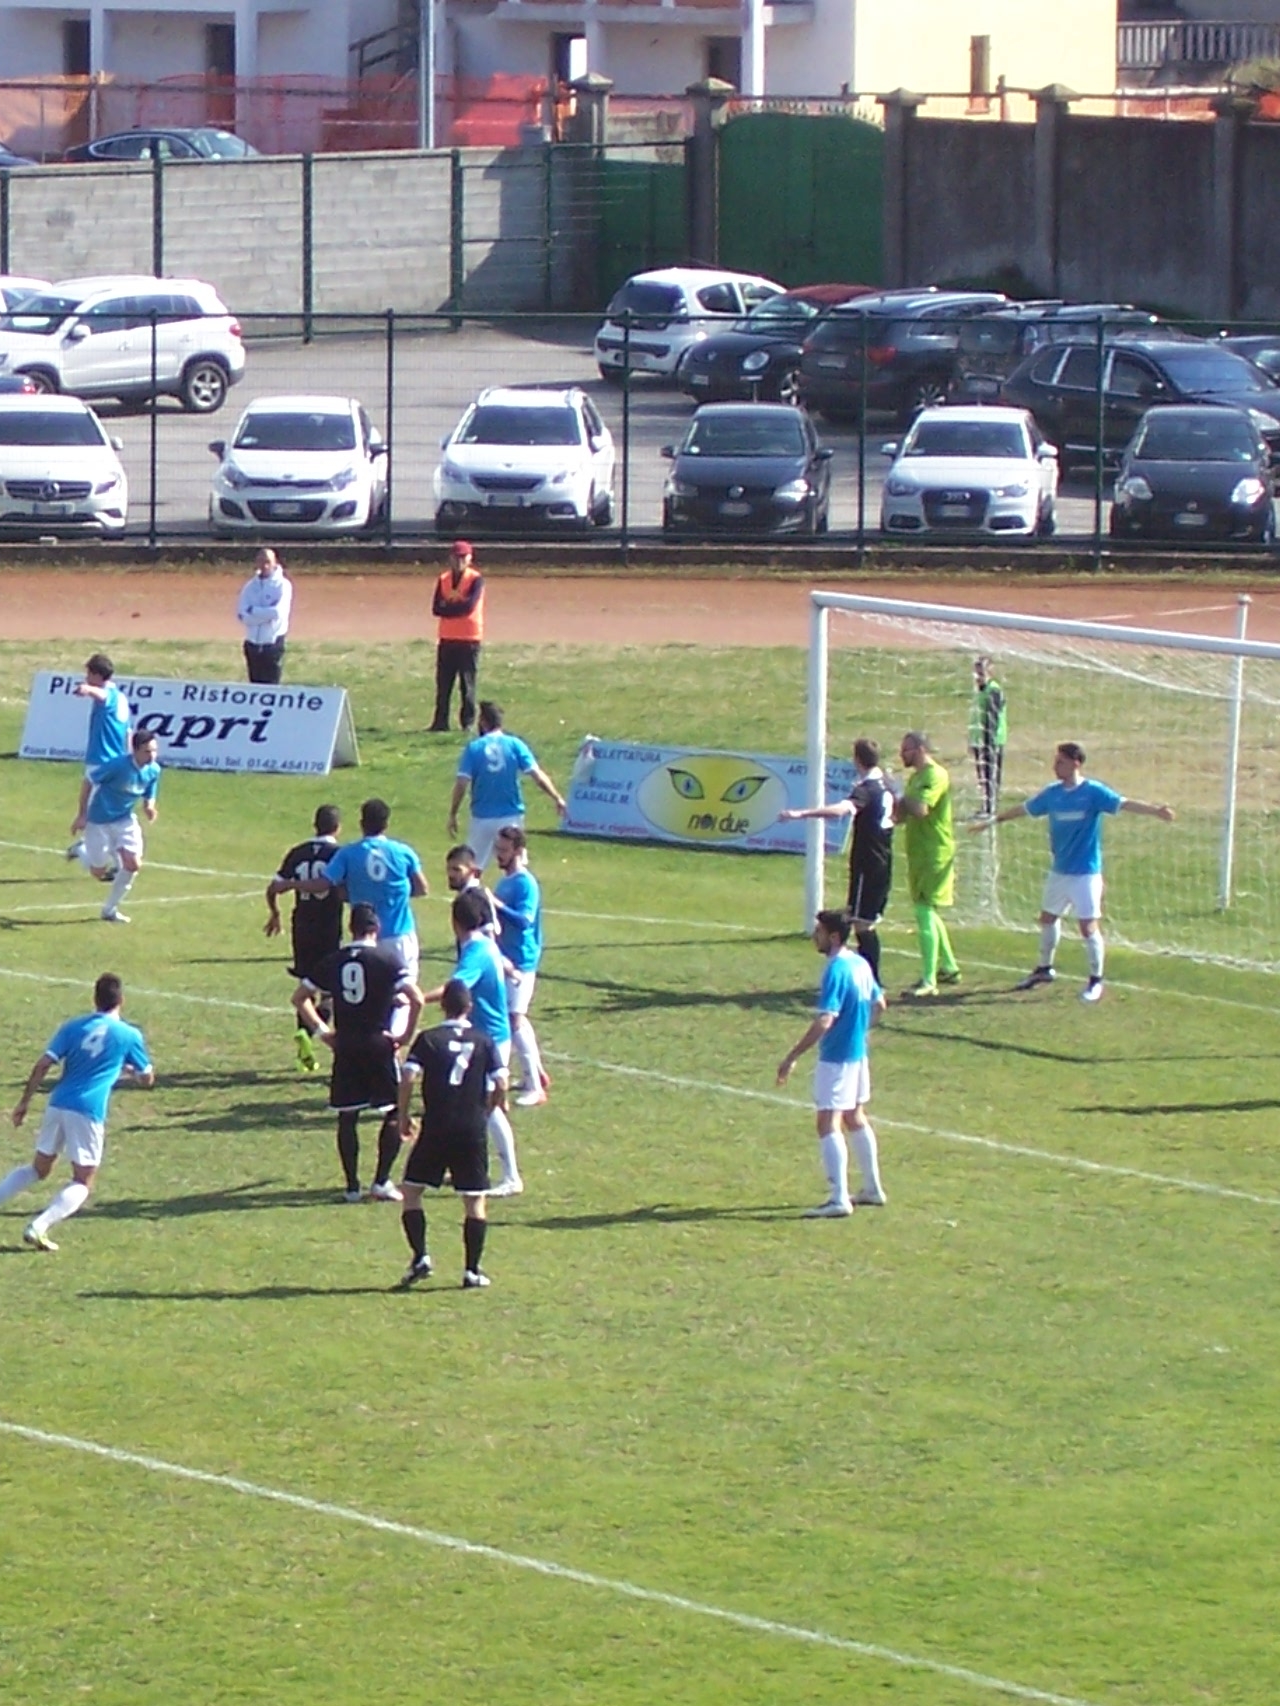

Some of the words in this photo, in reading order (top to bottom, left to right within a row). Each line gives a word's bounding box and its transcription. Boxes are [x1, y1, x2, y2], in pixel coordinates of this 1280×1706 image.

[182, 684, 324, 712] Ristorante
[129, 702, 273, 749] apri
[341, 962, 367, 1005] 9
[448, 1041, 475, 1086] 7
